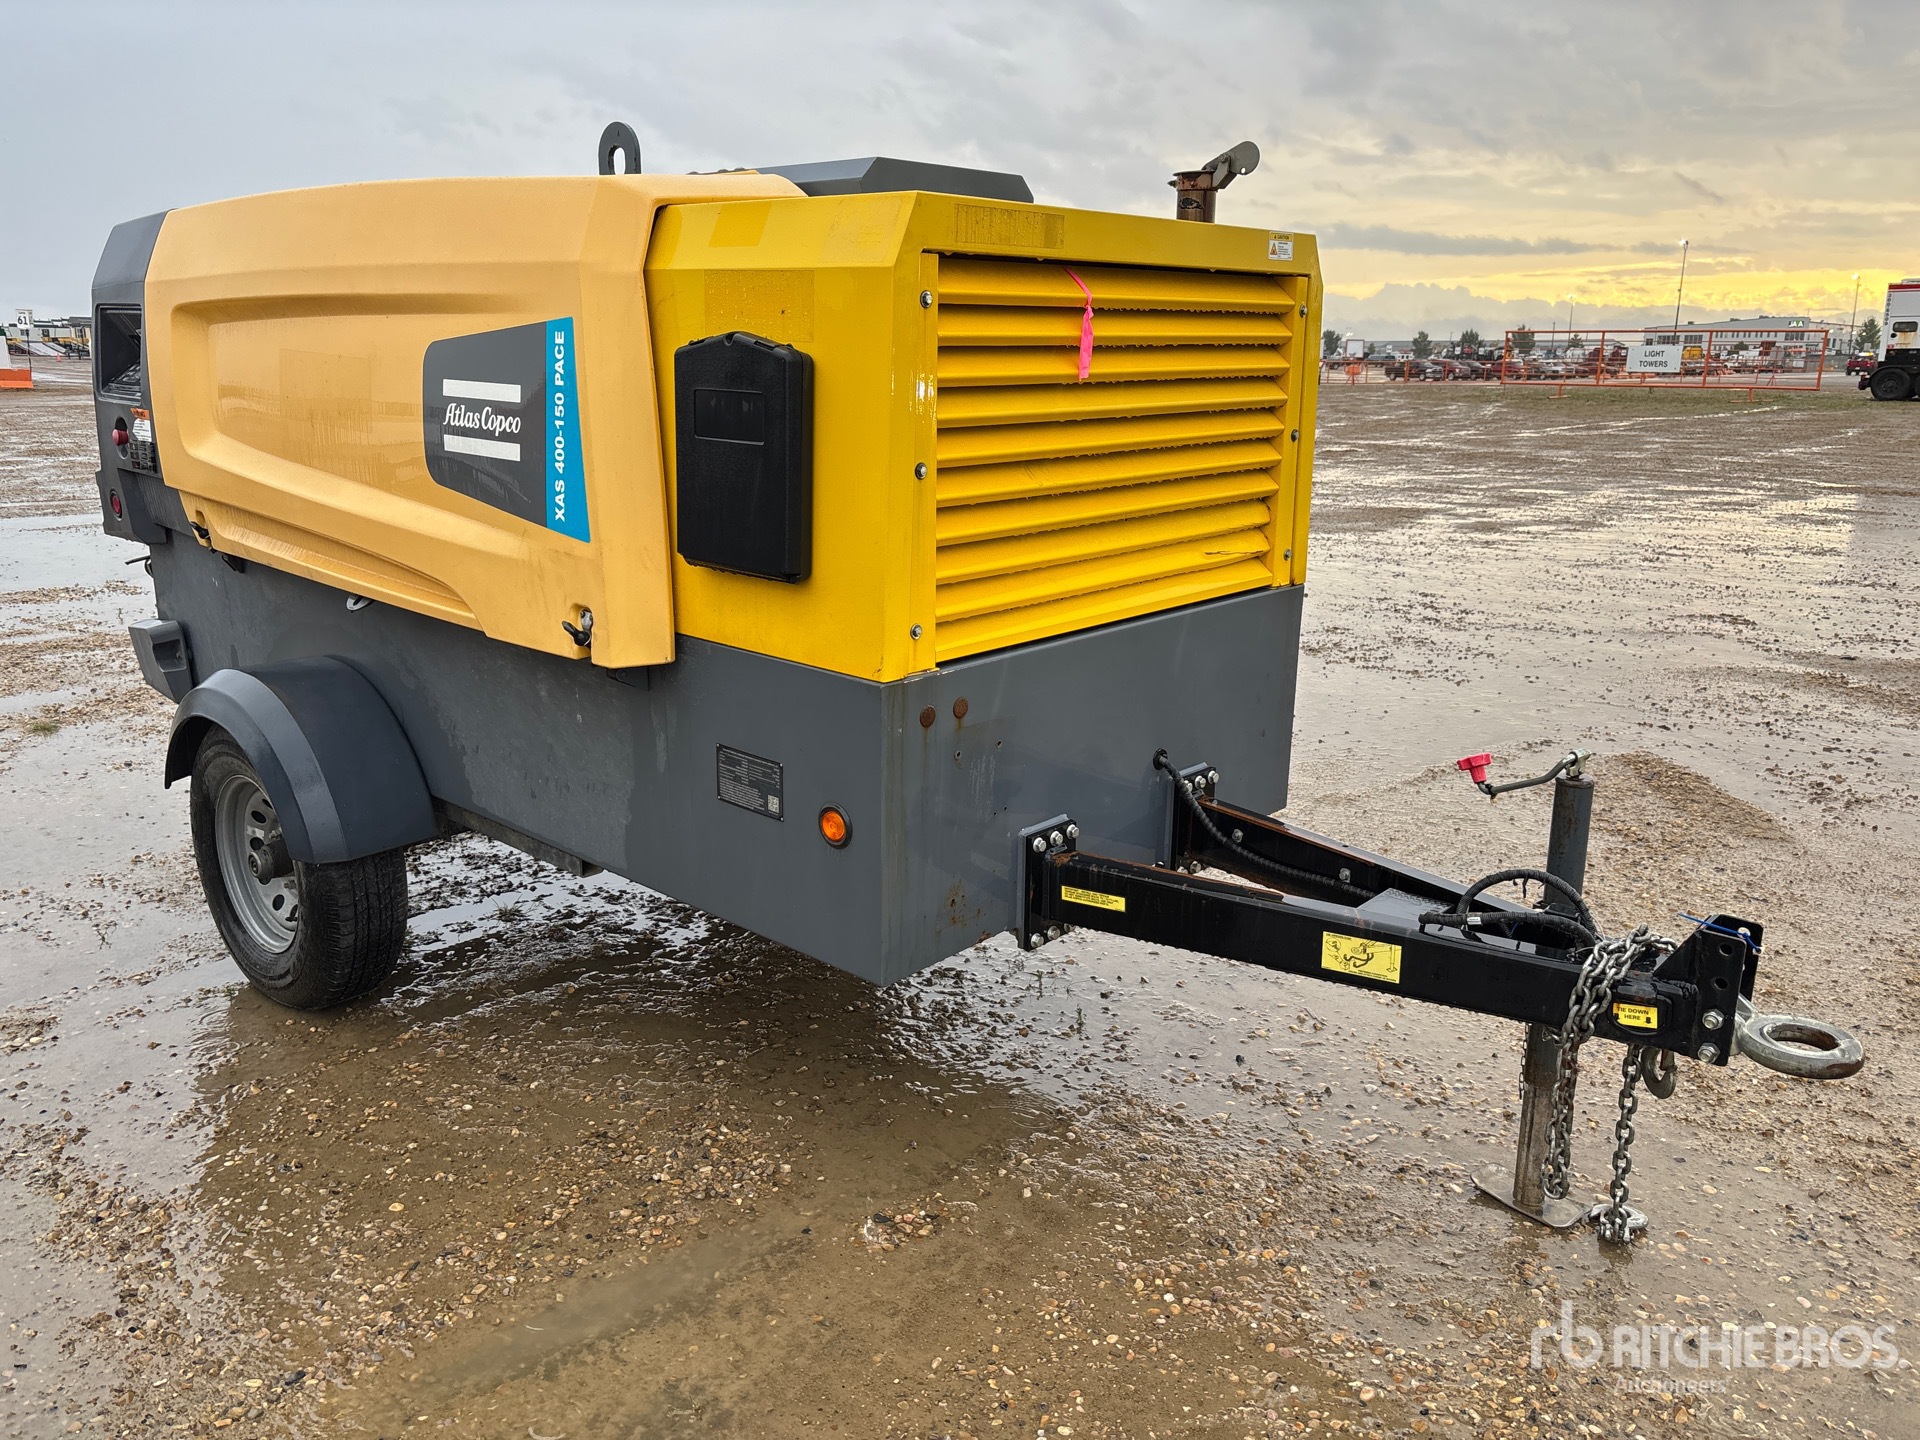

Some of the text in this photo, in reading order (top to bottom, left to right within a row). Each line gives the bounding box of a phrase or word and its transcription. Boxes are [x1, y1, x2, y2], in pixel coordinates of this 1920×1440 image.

[18, 316, 28, 325] 61
[1644, 350, 1665, 358] LIGHT
[1639, 360, 1668, 368] TOWERS
[442, 402, 522, 437] Atlas Copco
[554, 330, 566, 523] XAS 400-150 PACE
